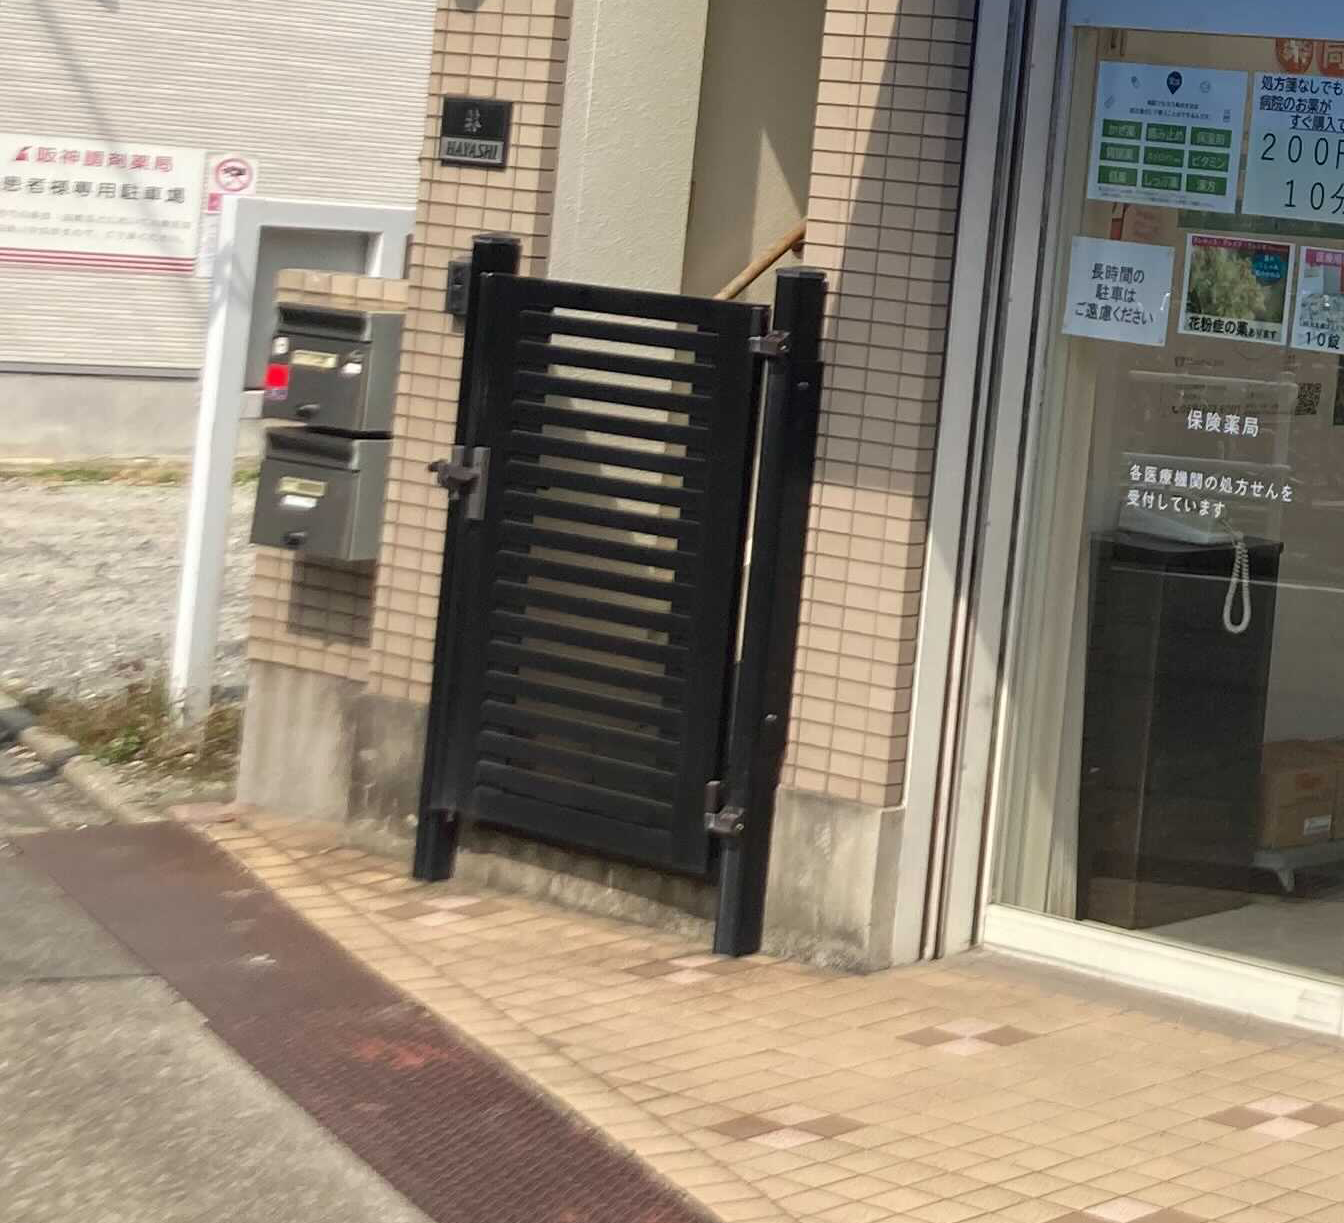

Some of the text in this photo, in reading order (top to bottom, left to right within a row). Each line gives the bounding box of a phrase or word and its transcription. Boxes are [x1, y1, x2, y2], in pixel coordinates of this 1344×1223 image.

[447, 140, 498, 160] HAYASHI
[1091, 262, 1145, 285] 長時間の
[1095, 283, 1137, 303] 駐車は
[1074, 301, 1154, 325] ご遠慮ください
[1186, 409, 1259, 438] 保険薬局
[1128, 463, 1294, 503] 各医療機関の処方せんを
[1126, 489, 1225, 518] 受付しています
